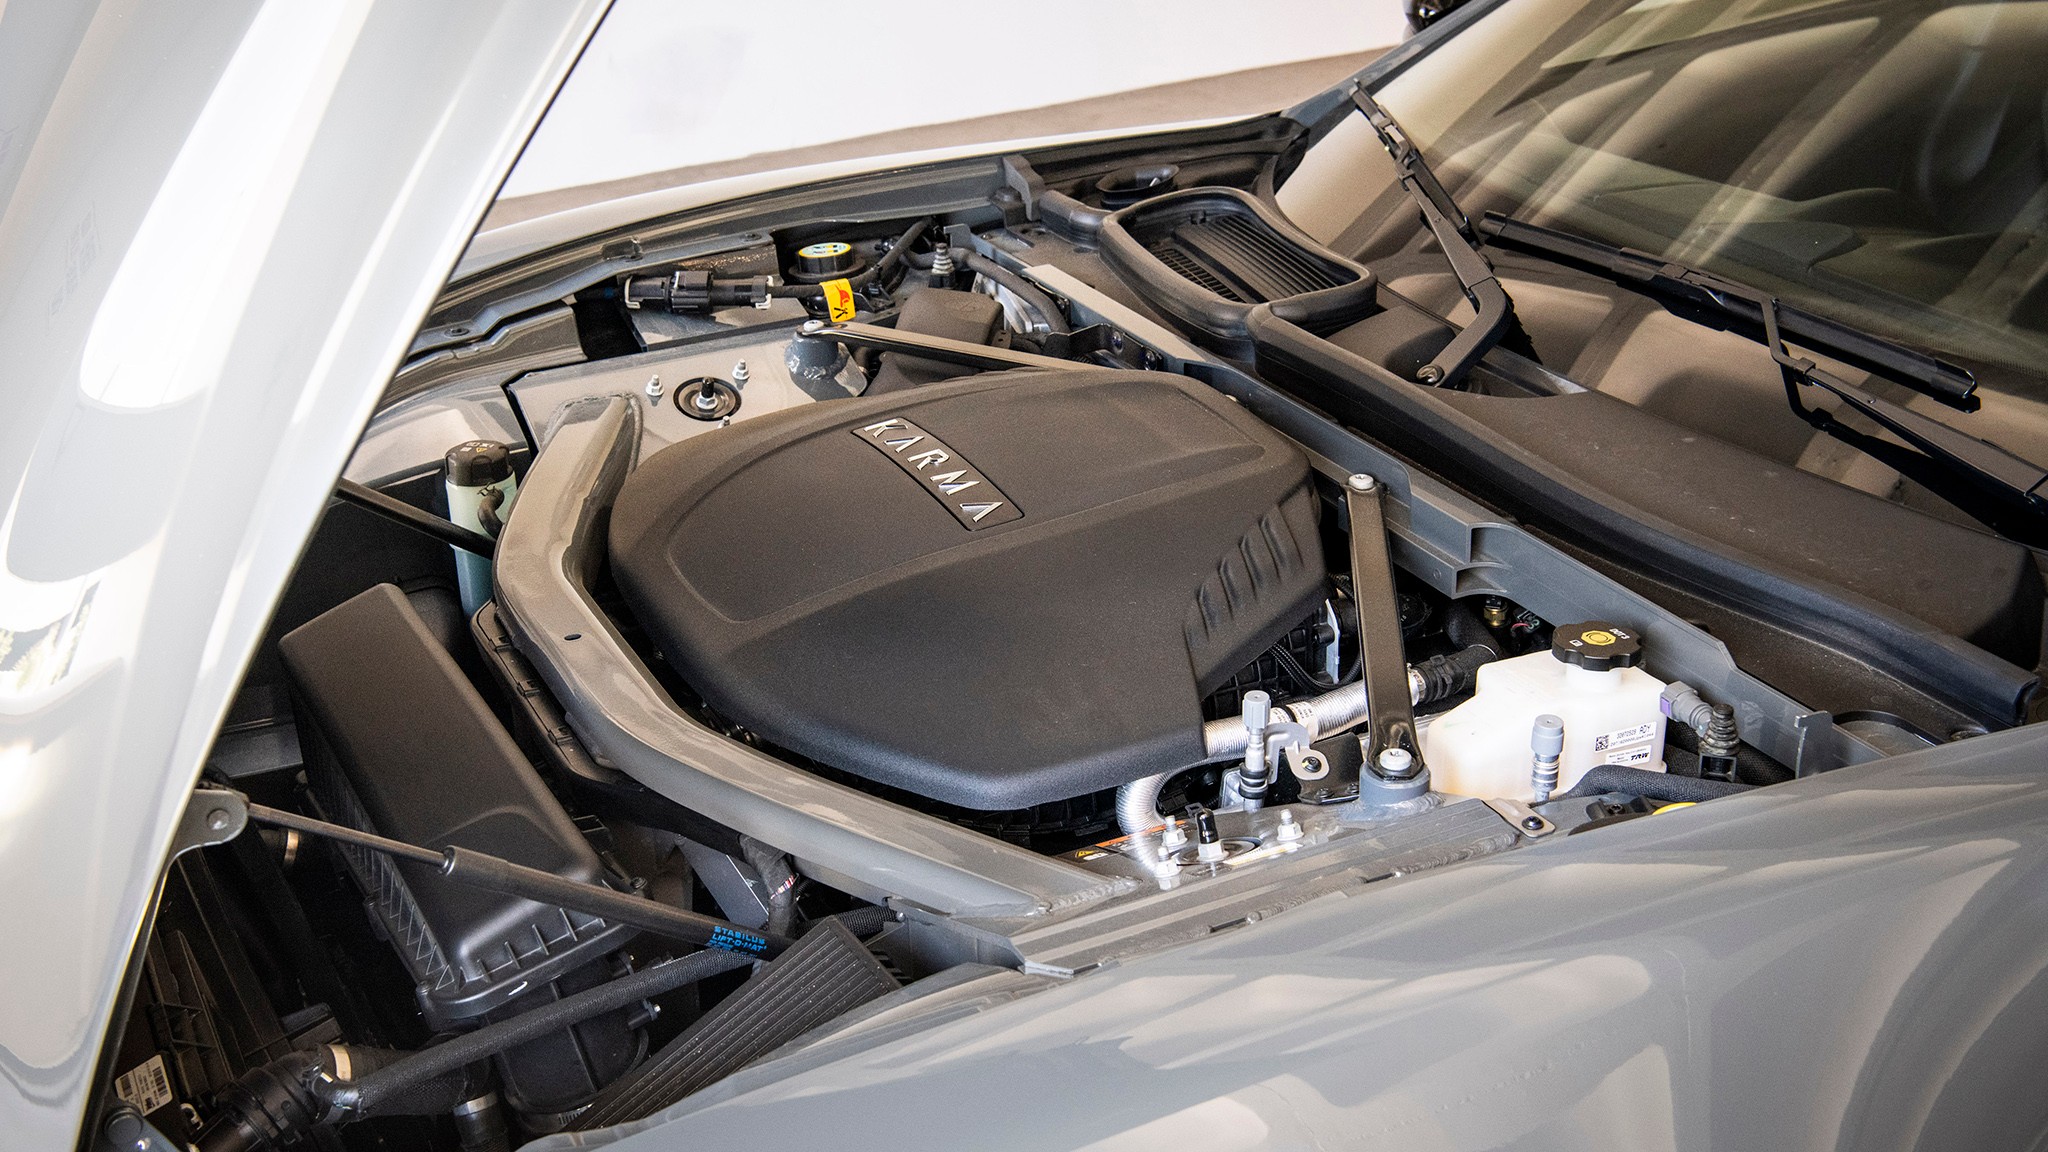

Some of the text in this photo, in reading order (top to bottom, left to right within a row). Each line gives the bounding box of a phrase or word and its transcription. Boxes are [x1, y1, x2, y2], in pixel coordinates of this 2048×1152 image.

[863, 418, 1004, 523] KARMA
[1630, 752, 1650, 761] TRW
[714, 925, 765, 945] STABILUS
